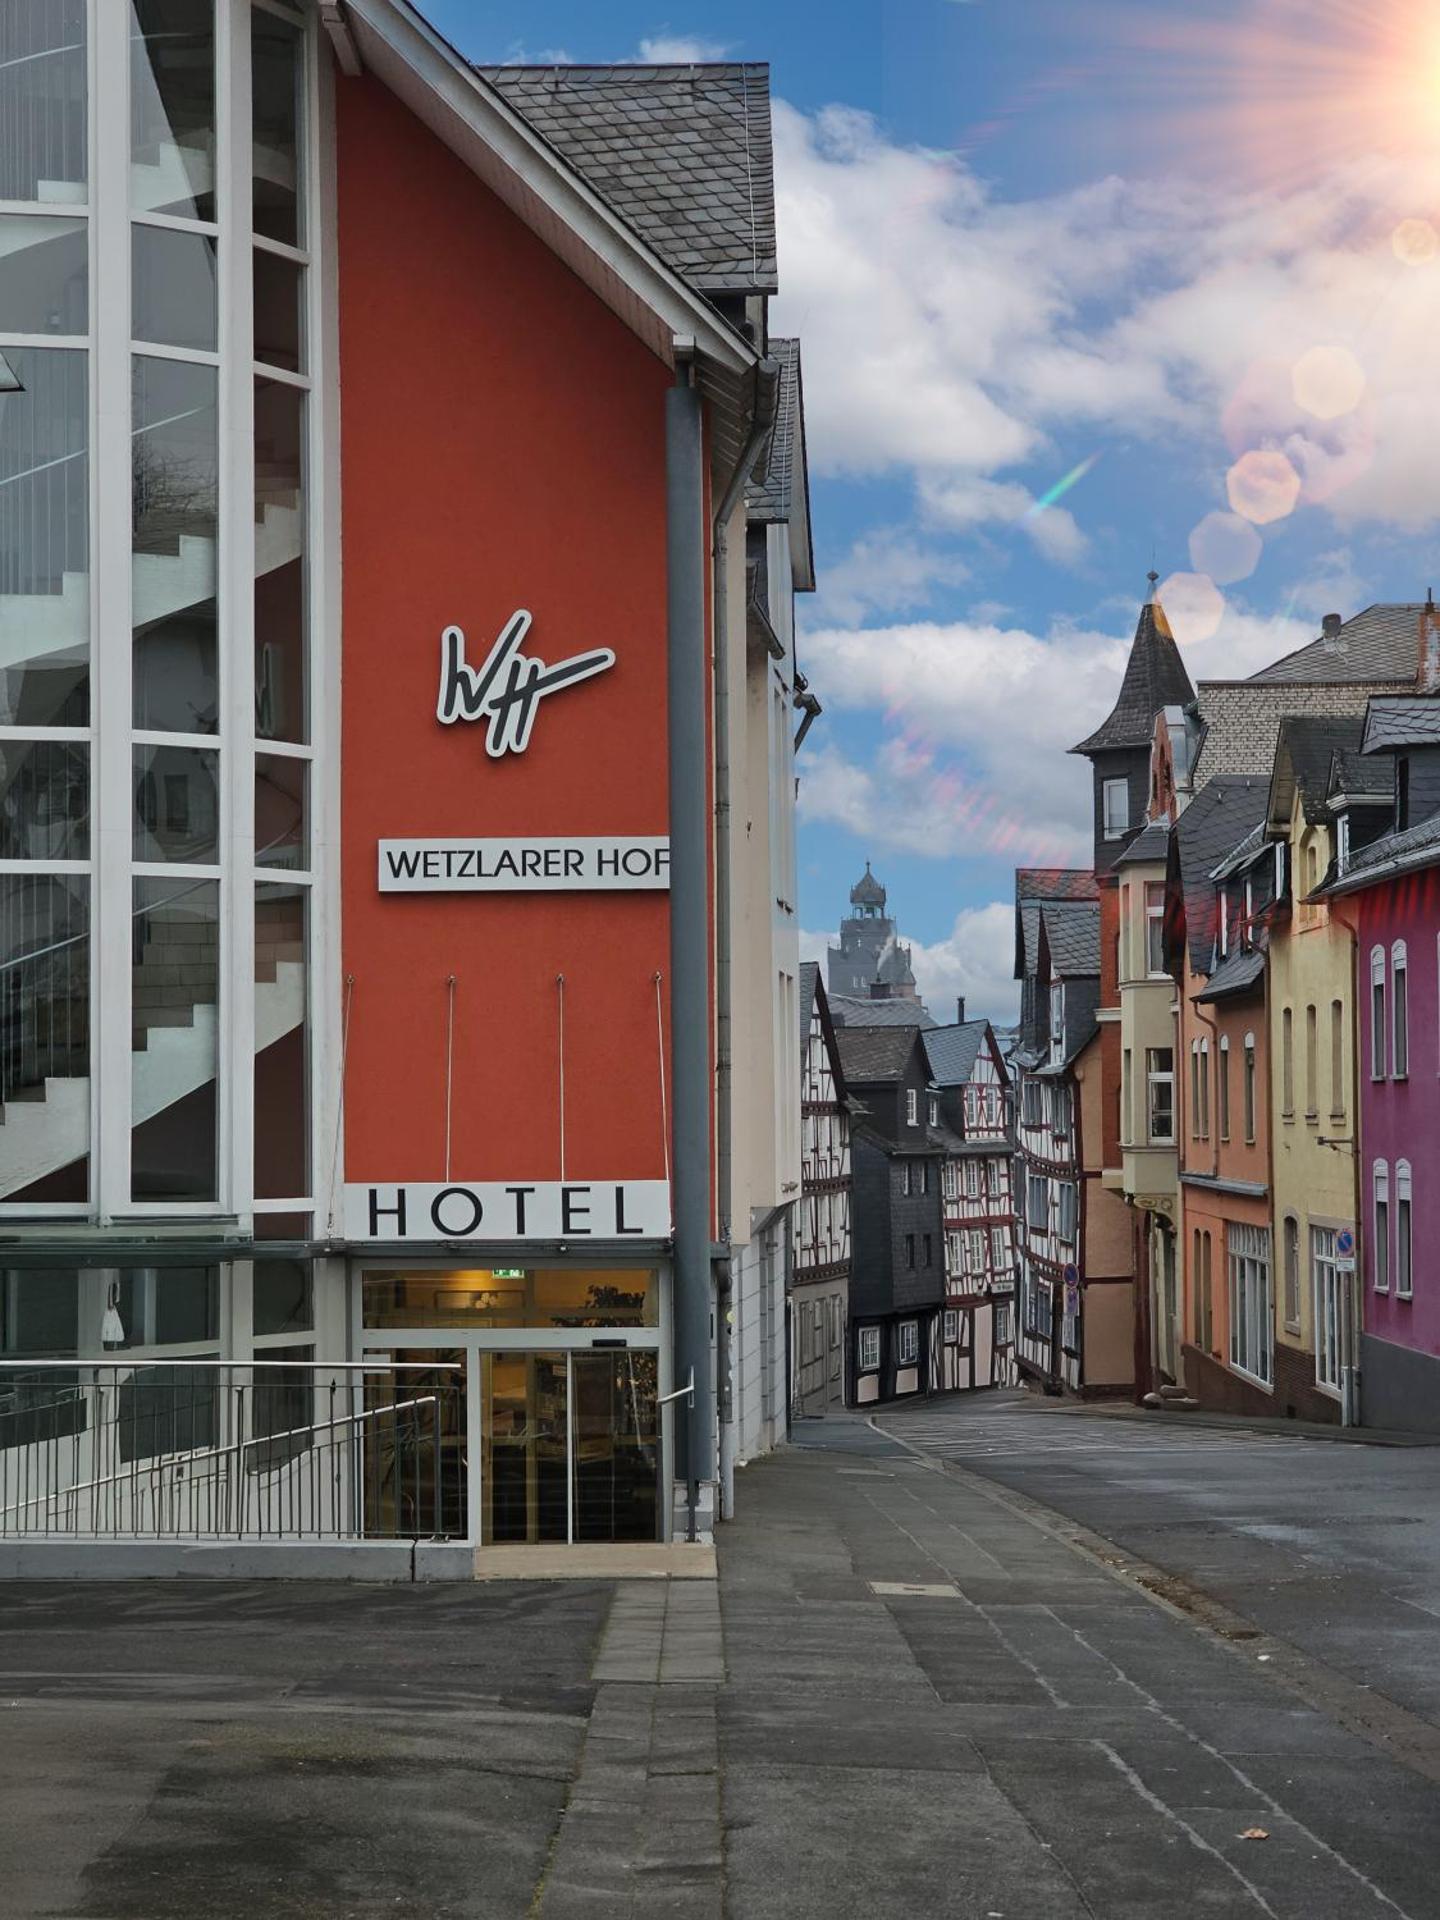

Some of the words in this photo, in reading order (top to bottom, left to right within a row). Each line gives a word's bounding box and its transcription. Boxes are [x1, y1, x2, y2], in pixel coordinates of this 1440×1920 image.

[387, 849, 584, 878] WETZLARER
[597, 848, 670, 876] HOF
[368, 1186, 644, 1237] HOTEL
